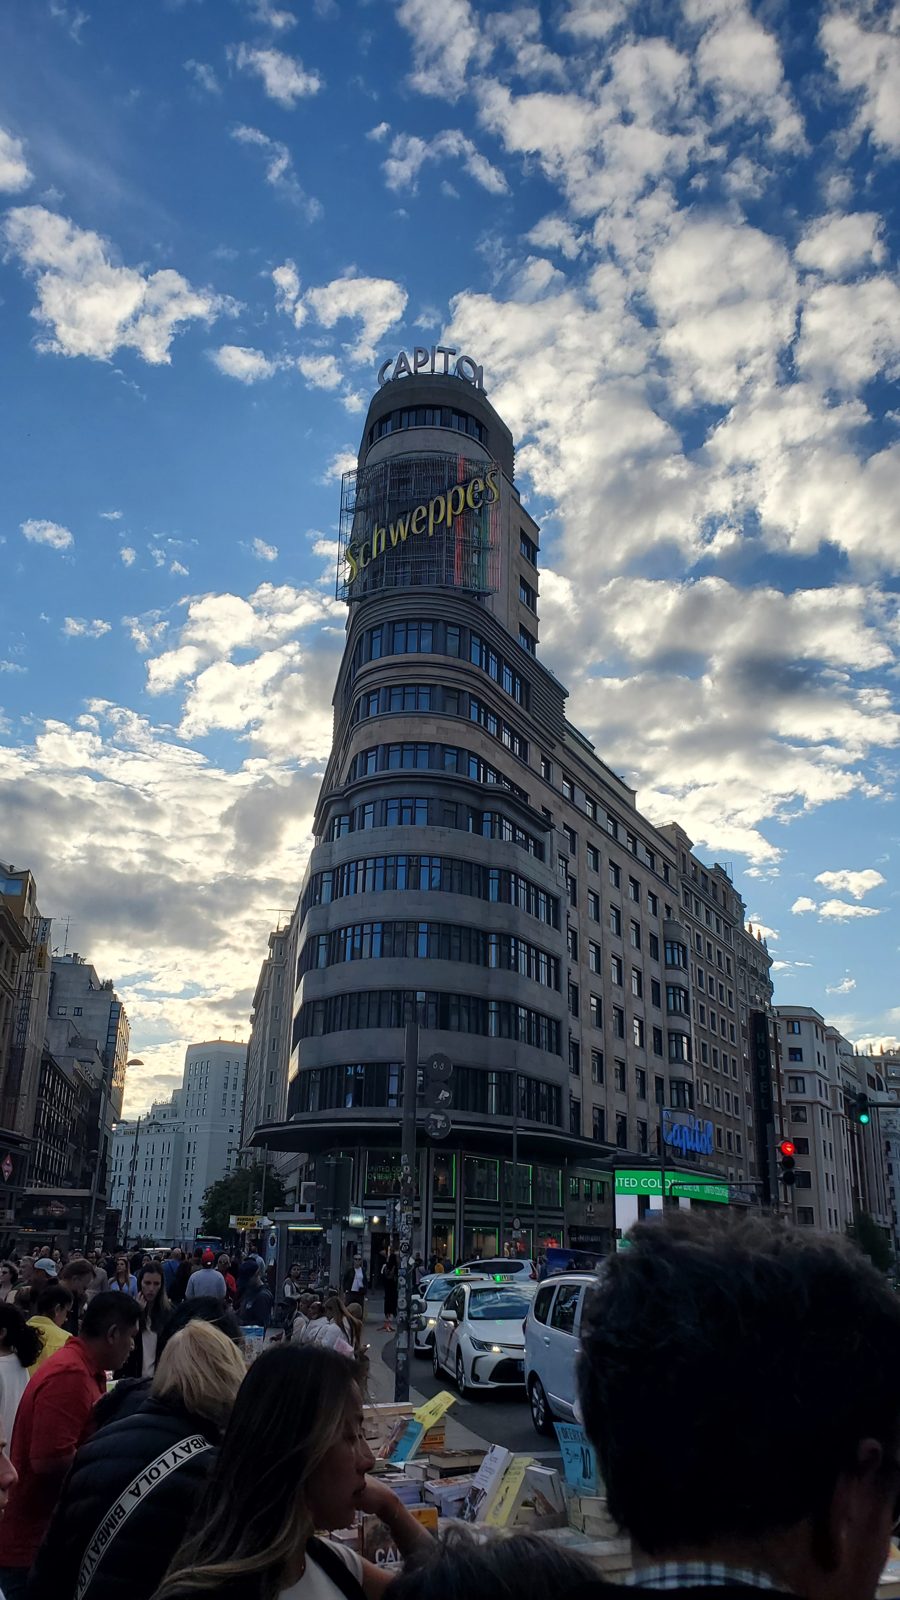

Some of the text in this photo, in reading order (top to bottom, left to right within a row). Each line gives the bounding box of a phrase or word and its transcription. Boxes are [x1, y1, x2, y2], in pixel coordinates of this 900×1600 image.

[378, 345, 487, 396] CAPITOL
[345, 468, 501, 586] Schweppes
[756, 1031, 768, 1111] HOTEL
[565, 1447, 573, 1464] 3
